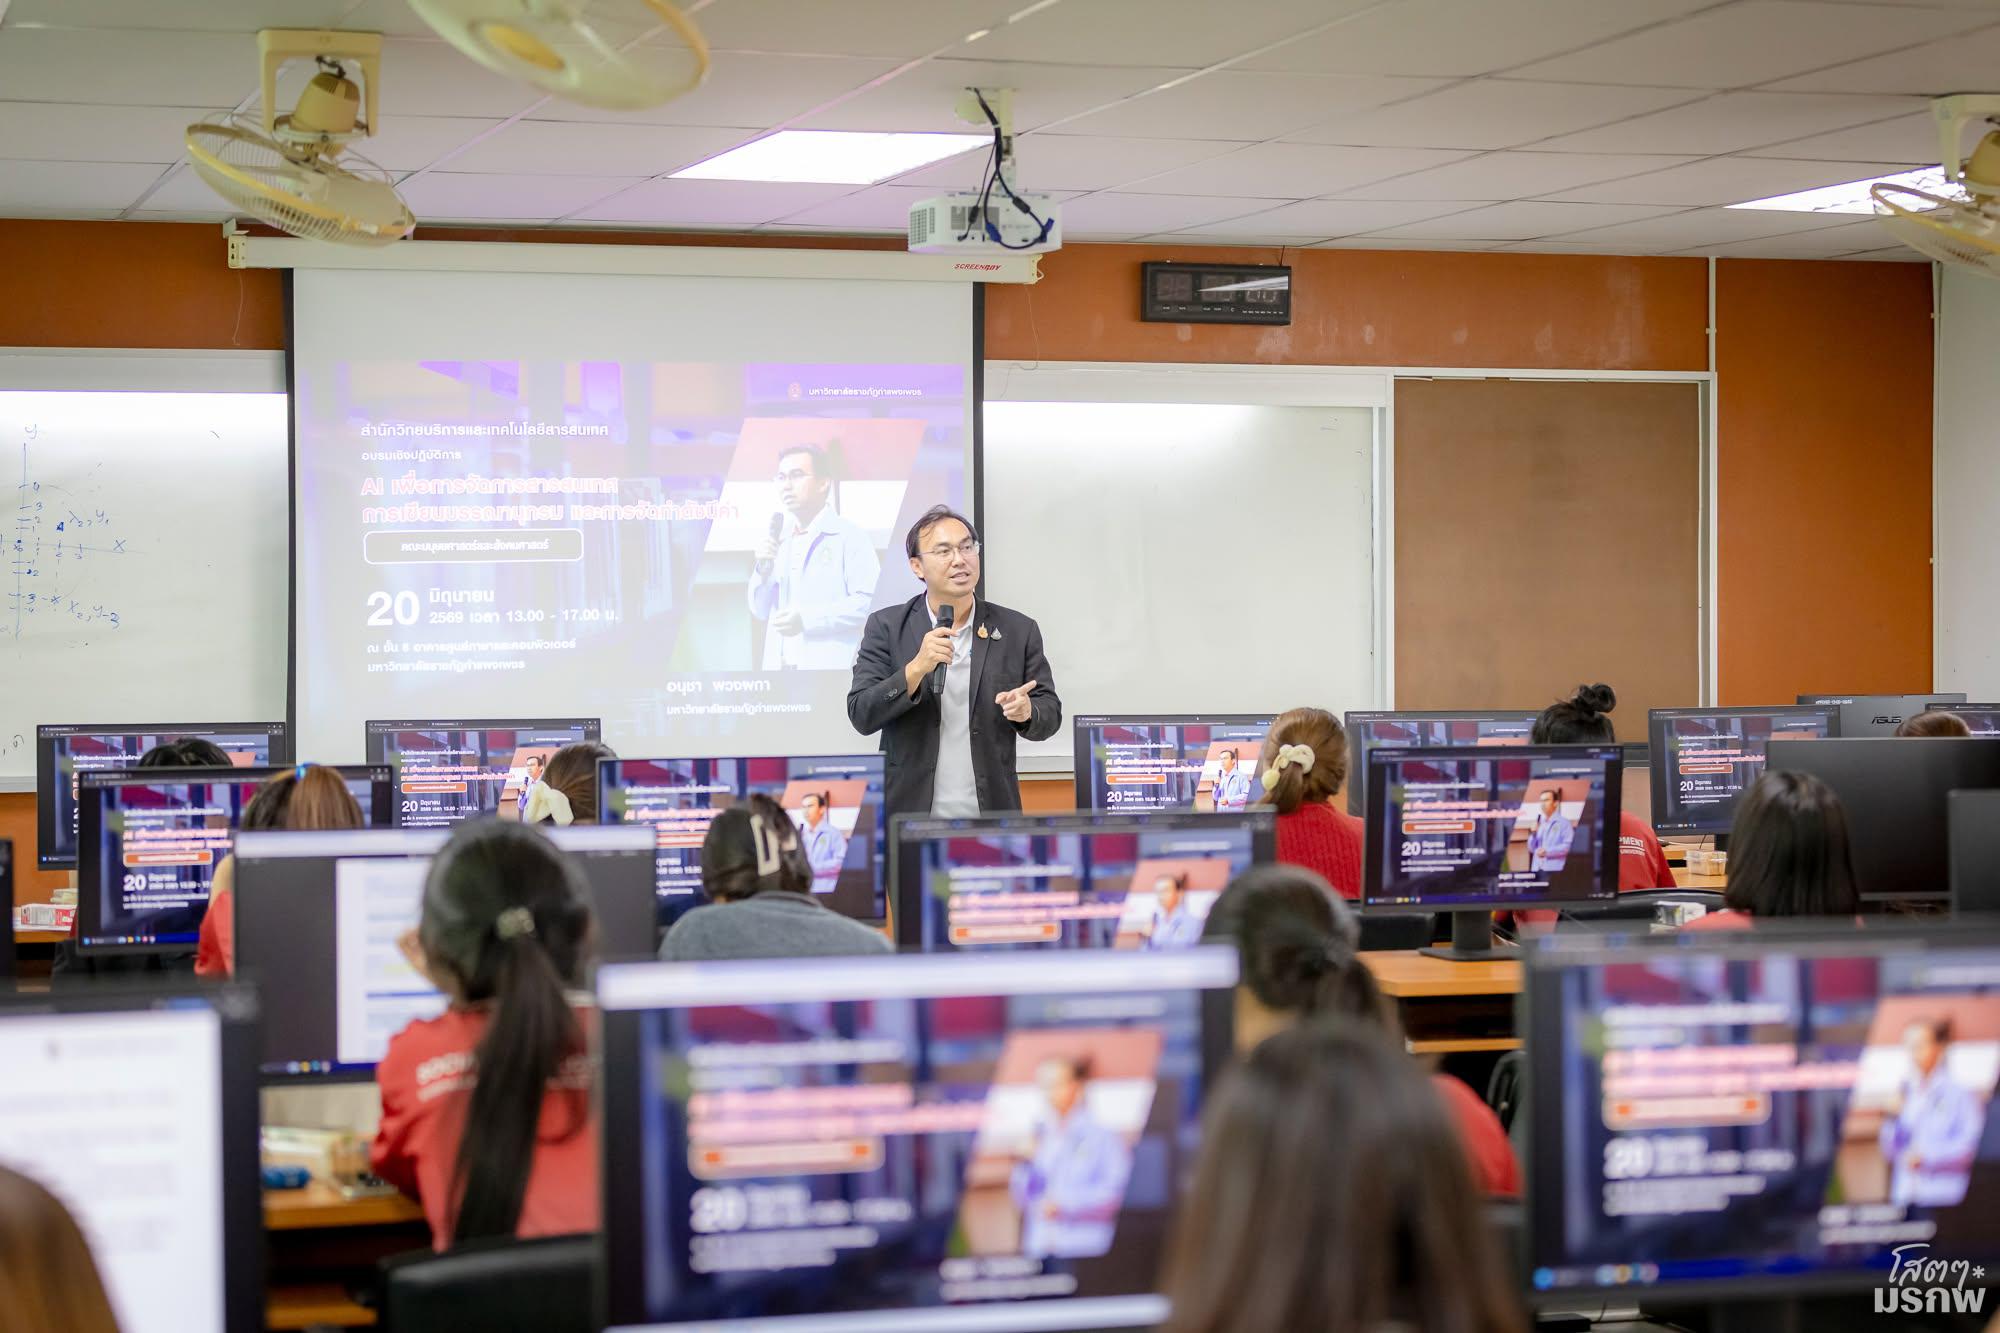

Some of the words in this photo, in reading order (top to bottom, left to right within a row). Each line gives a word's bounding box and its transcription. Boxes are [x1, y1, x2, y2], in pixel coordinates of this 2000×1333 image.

[361, 422, 609, 437] สำนักวิทยบริการและเทคโนโลยีสารสนเทศ
[361, 450, 462, 462] อบรมเชิงปฏิบัติการ
[361, 478, 384, 496] AI
[392, 470, 619, 495] เพื่อการจัดการสารสนเทศ
[429, 588, 495, 607] มิถุนายน
[367, 590, 420, 626] 20
[429, 611, 464, 624] 2569
[470, 611, 500, 623] เวลา
[506, 610, 544, 623] 13.00
[562, 609, 599, 621] 17.00
[368, 659, 525, 672] มหาวิทยาลัยราชภัฏกำแพงเพชร
[667, 680, 702, 696] อนุชา
[667, 703, 811, 715] มหาวิทยาลัยราชภัฏกำแพงเพชร
[1872, 716, 1902, 724] ASUS
[1680, 780, 1694, 792] 20
[1107, 791, 1122, 803] 20
[401, 801, 418, 812] 20
[1401, 841, 1421, 857] 20
[123, 874, 147, 892] 20
